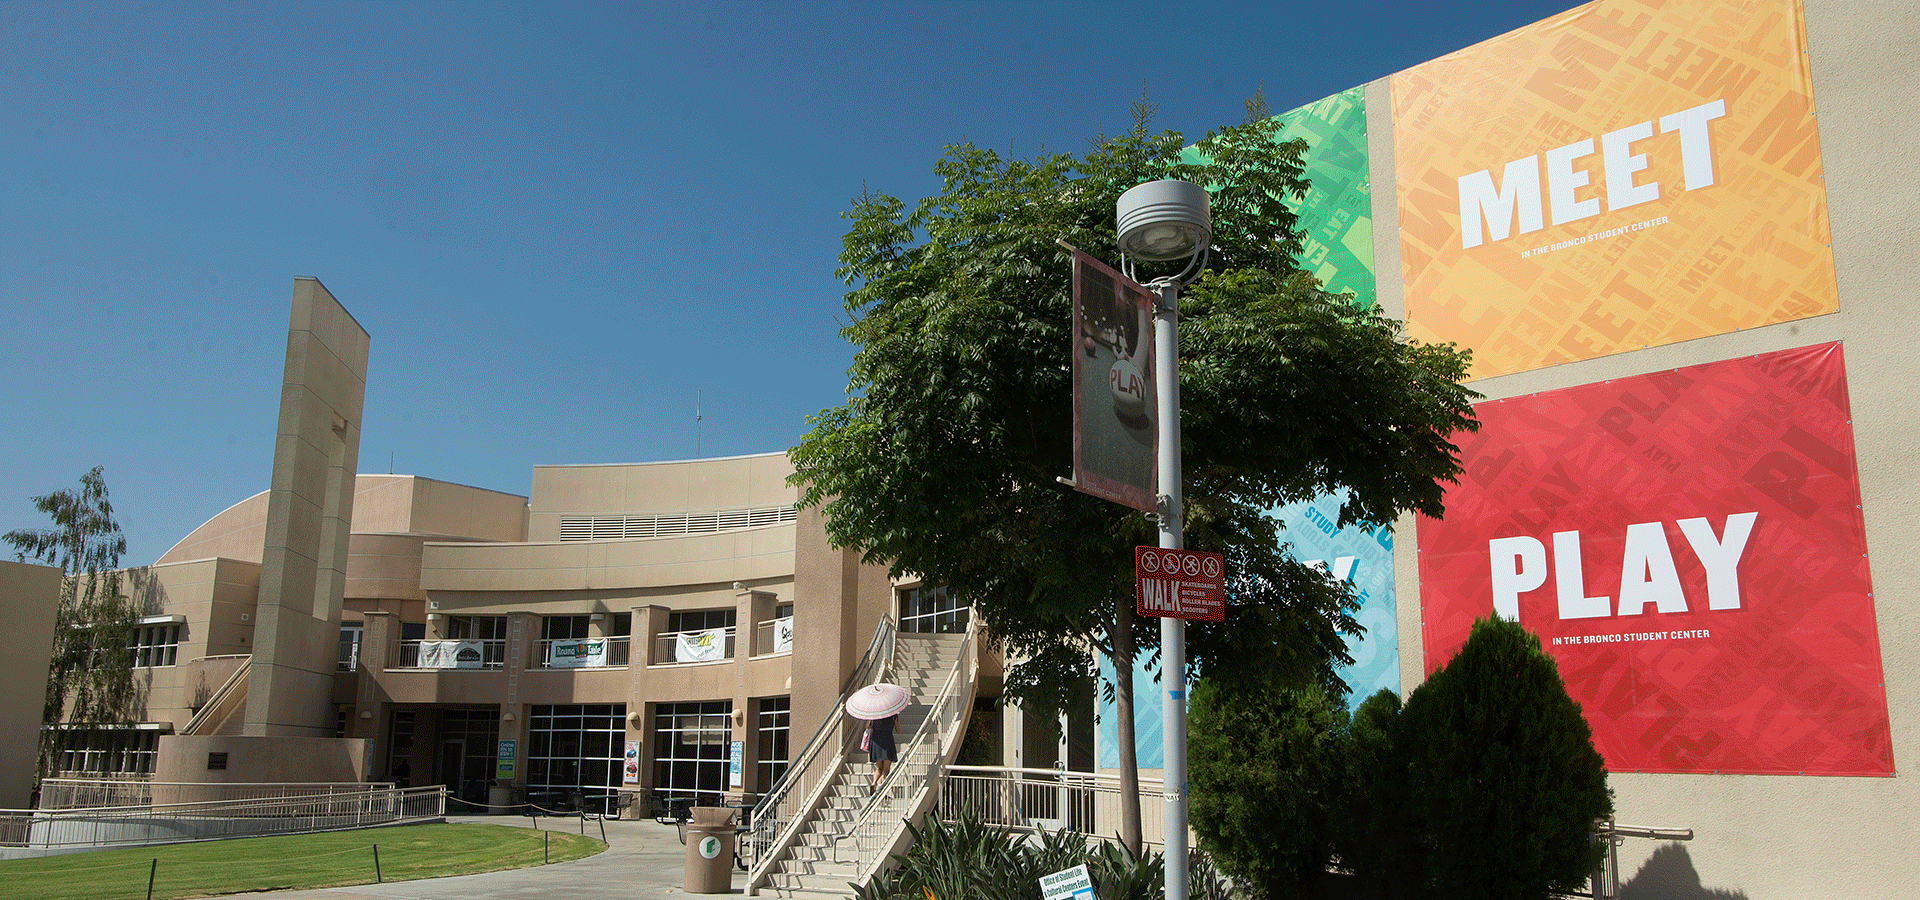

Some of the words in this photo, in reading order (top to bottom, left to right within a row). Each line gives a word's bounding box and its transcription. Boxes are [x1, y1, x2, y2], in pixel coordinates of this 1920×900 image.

[1412, 87, 1450, 131] MEET
[1603, 108, 1626, 132] MEET
[1457, 98, 1726, 249] MEET
[1322, 207, 1351, 241] EAT
[1521, 250, 1531, 259] IN
[1532, 246, 1549, 257] THE
[1550, 236, 1587, 252] BRONCO
[1588, 225, 1630, 243] STUDENT
[1631, 215, 1669, 232] CENTER
[1677, 235, 1737, 295] MEET
[1110, 368, 1145, 401] PLAY
[1642, 444, 1682, 475] PLAY
[1304, 506, 1342, 540] STUDY
[1489, 511, 1759, 622] PLAY
[1142, 578, 1181, 612] WALK
[1181, 581, 1217, 590] SKATEBOARDS
[1201, 599, 1221, 607] BLADES
[556, 646, 576, 656] Round
[587, 644, 602, 655] Table
[686, 633, 716, 648] SUBWAY
[1552, 636, 1562, 645] IN
[1563, 636, 1582, 645] THE
[1583, 633, 1622, 644] BRONCO
[1623, 631, 1668, 642] STUDENT
[1670, 629, 1711, 639] CENTER
[1044, 876, 1056, 887] Office
[1055, 874, 1060, 884] of
[1059, 869, 1075, 882] Student
[1074, 868, 1082, 878] Life
[1047, 886, 1063, 898] Cultural
[1062, 882, 1078, 893] Centers
[1077, 878, 1090, 889] Event
